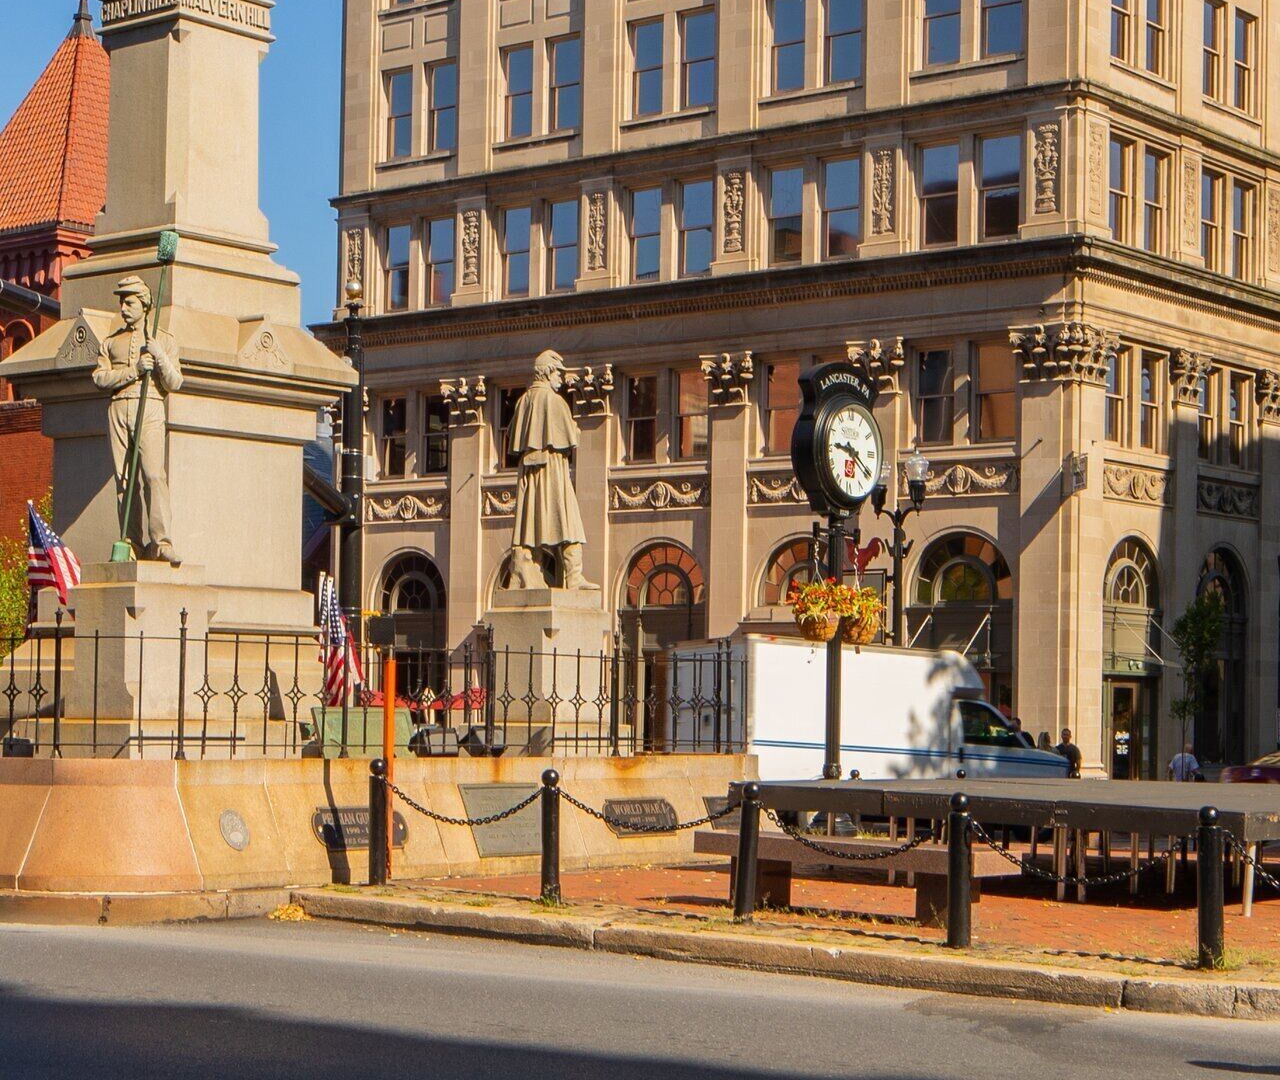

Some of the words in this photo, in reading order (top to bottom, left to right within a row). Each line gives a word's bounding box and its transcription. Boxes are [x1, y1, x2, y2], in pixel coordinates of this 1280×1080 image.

[244, 7, 270, 31] HILL
[820, 373, 860, 391] LANCASTER,
[861, 383, 870, 400] PA
[612, 803, 643, 816] WORLD
[643, 803, 661, 815] WAR
